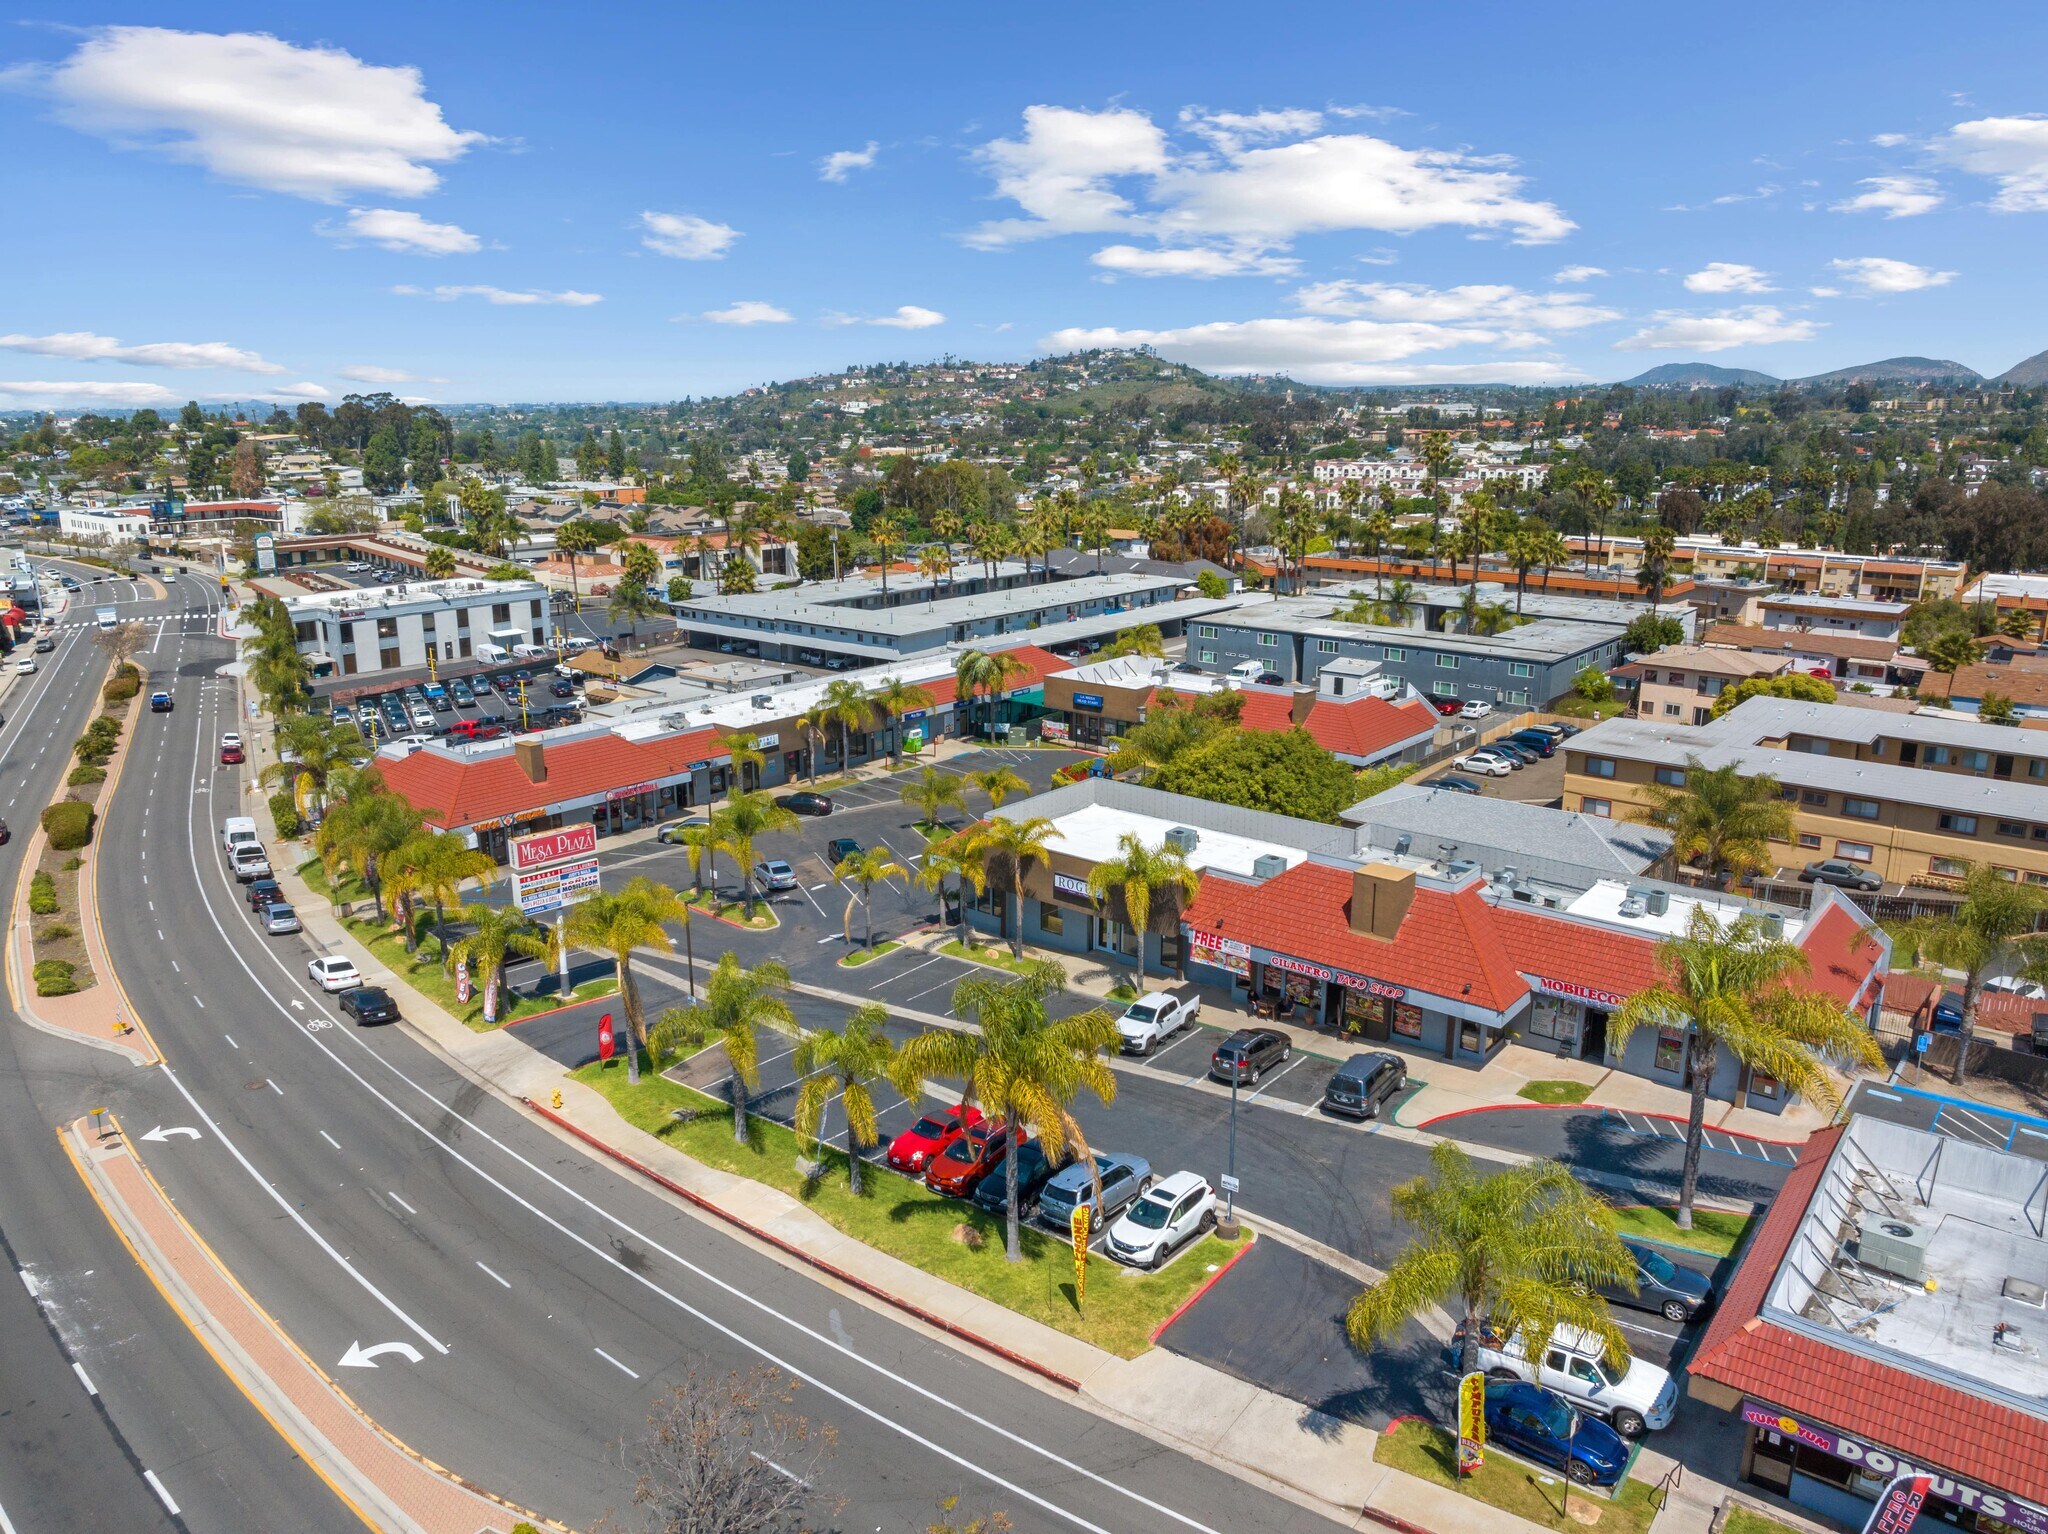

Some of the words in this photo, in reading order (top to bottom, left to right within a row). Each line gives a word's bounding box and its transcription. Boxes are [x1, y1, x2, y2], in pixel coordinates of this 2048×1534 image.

[521, 843, 553, 862] MESA
[556, 834, 593, 854] PLAZA
[561, 874, 598, 887] DONUTS
[561, 879, 599, 892] MOBILECOM
[1194, 930, 1223, 950] FREE
[1270, 956, 1331, 980] CILANTRO
[1336, 972, 1367, 990] TACO
[1369, 982, 1404, 999] SHOP
[1746, 1411, 1780, 1428] YUM
[1797, 1426, 1831, 1450] YUM
[1877, 1490, 1908, 1533] CELL
[2019, 1507, 2046, 1523] OPEN
[2025, 1516, 2037, 1525] 24
[2013, 1518, 2048, 1534] HOURS
